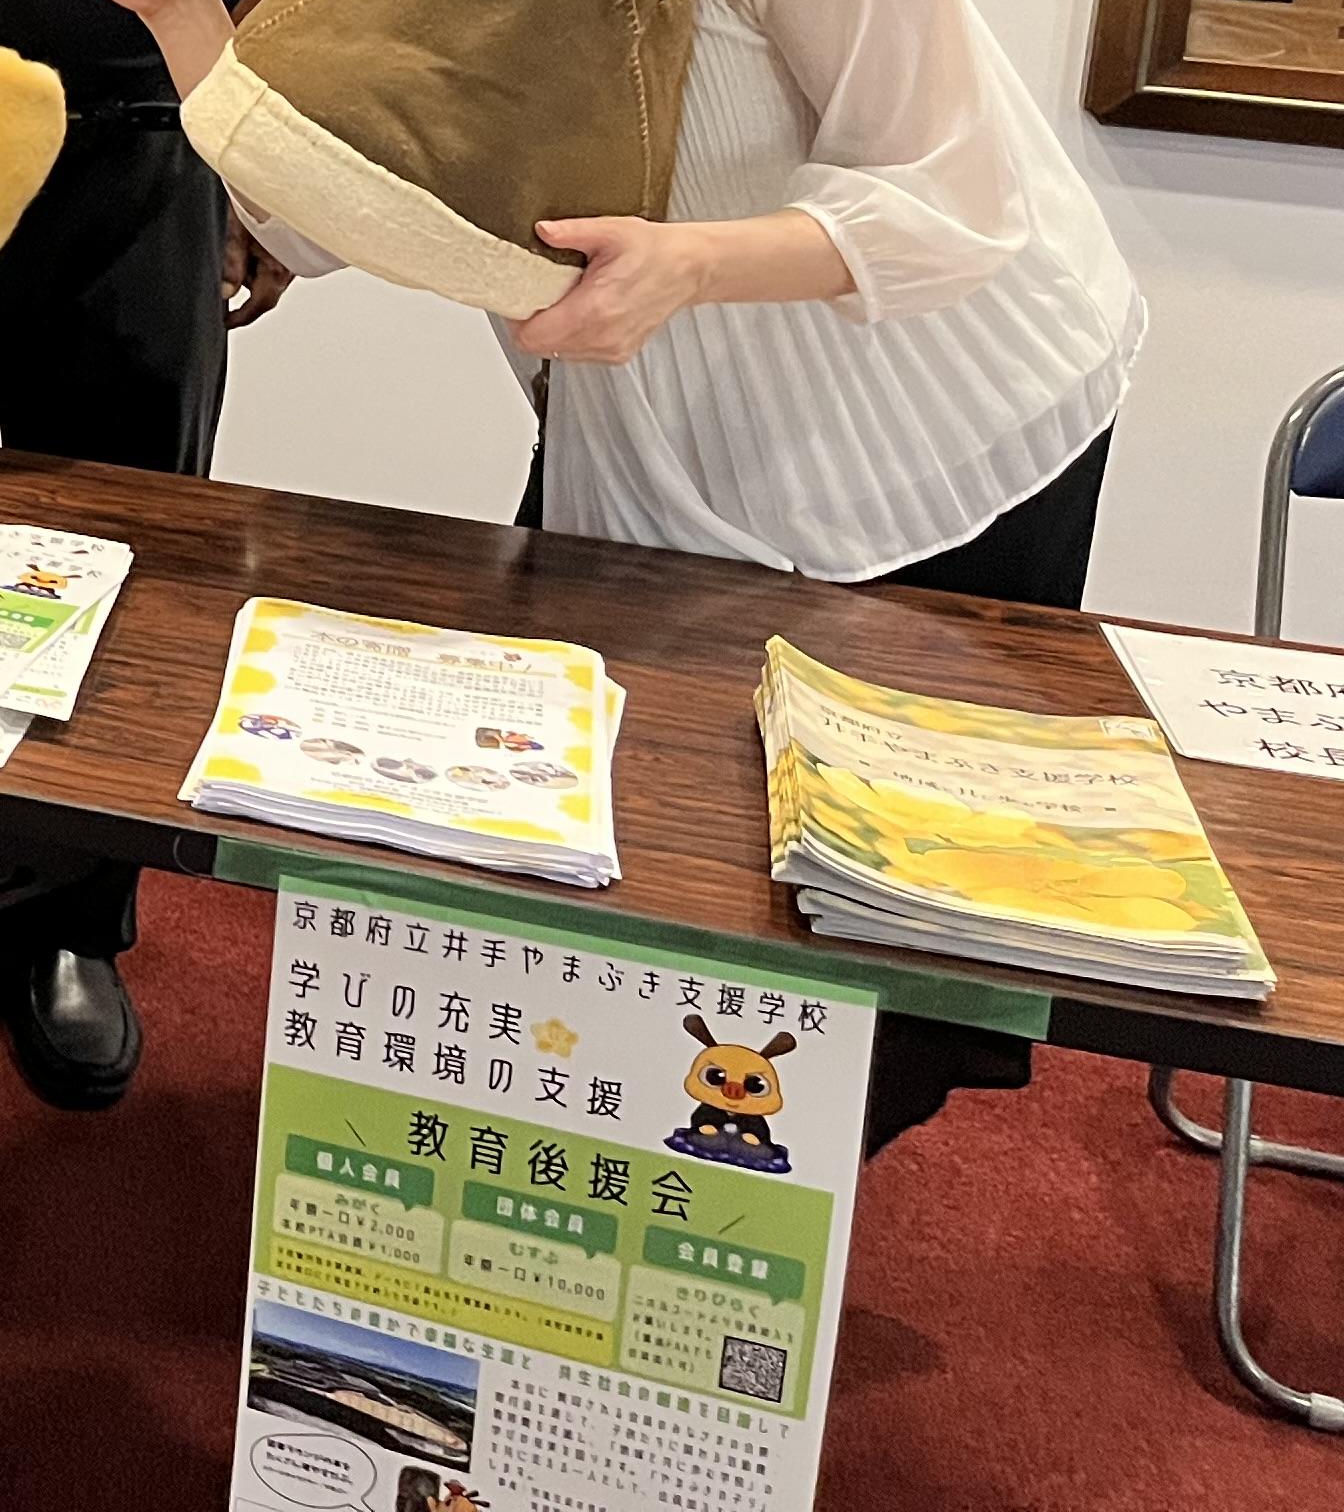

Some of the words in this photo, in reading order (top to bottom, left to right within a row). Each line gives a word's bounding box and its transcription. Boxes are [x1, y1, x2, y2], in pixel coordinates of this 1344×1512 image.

[288, 958, 522, 1045] 学びの充実
[292, 901, 828, 1035] 京都府立井手やまぶき支援学校
[284, 1008, 622, 1120] 教育環境の支援
[407, 1109, 693, 1221] 教育後援会
